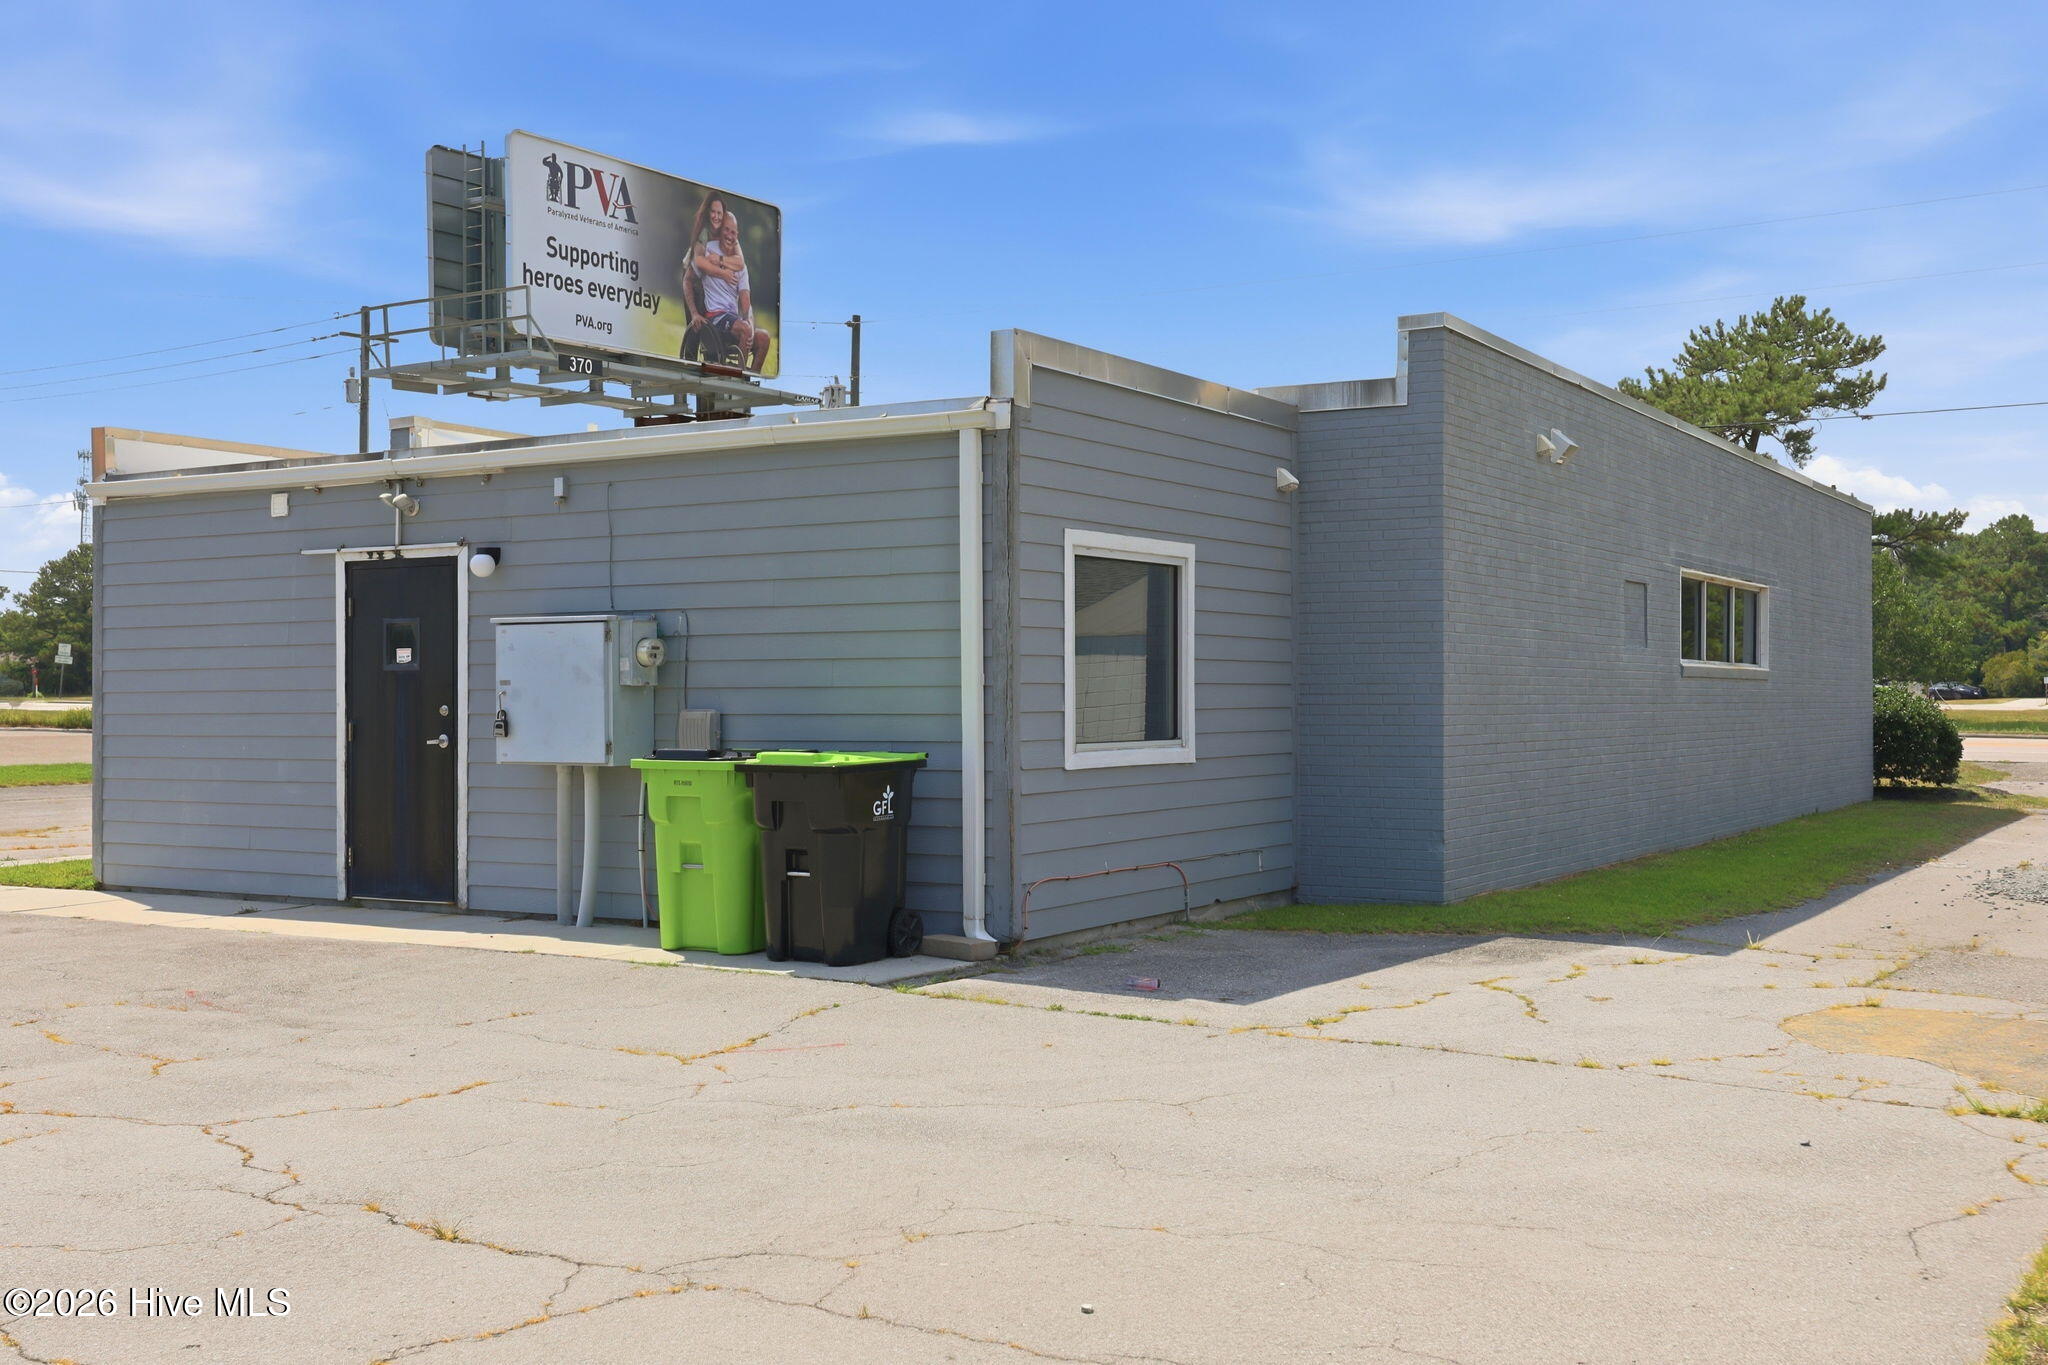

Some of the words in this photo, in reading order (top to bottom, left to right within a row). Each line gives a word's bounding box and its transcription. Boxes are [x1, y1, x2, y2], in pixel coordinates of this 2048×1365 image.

[563, 160, 639, 225] PVA
[547, 206, 578, 222] Paralyzed
[580, 214, 606, 228] Veterans
[607, 222, 614, 230] of
[614, 224, 639, 236] America
[546, 235, 639, 281] Supporting
[522, 262, 584, 295] heroes
[587, 281, 661, 316] everyday
[575, 313, 613, 335] PVA.org
[569, 356, 593, 374] 370
[872, 797, 894, 816] GFL
